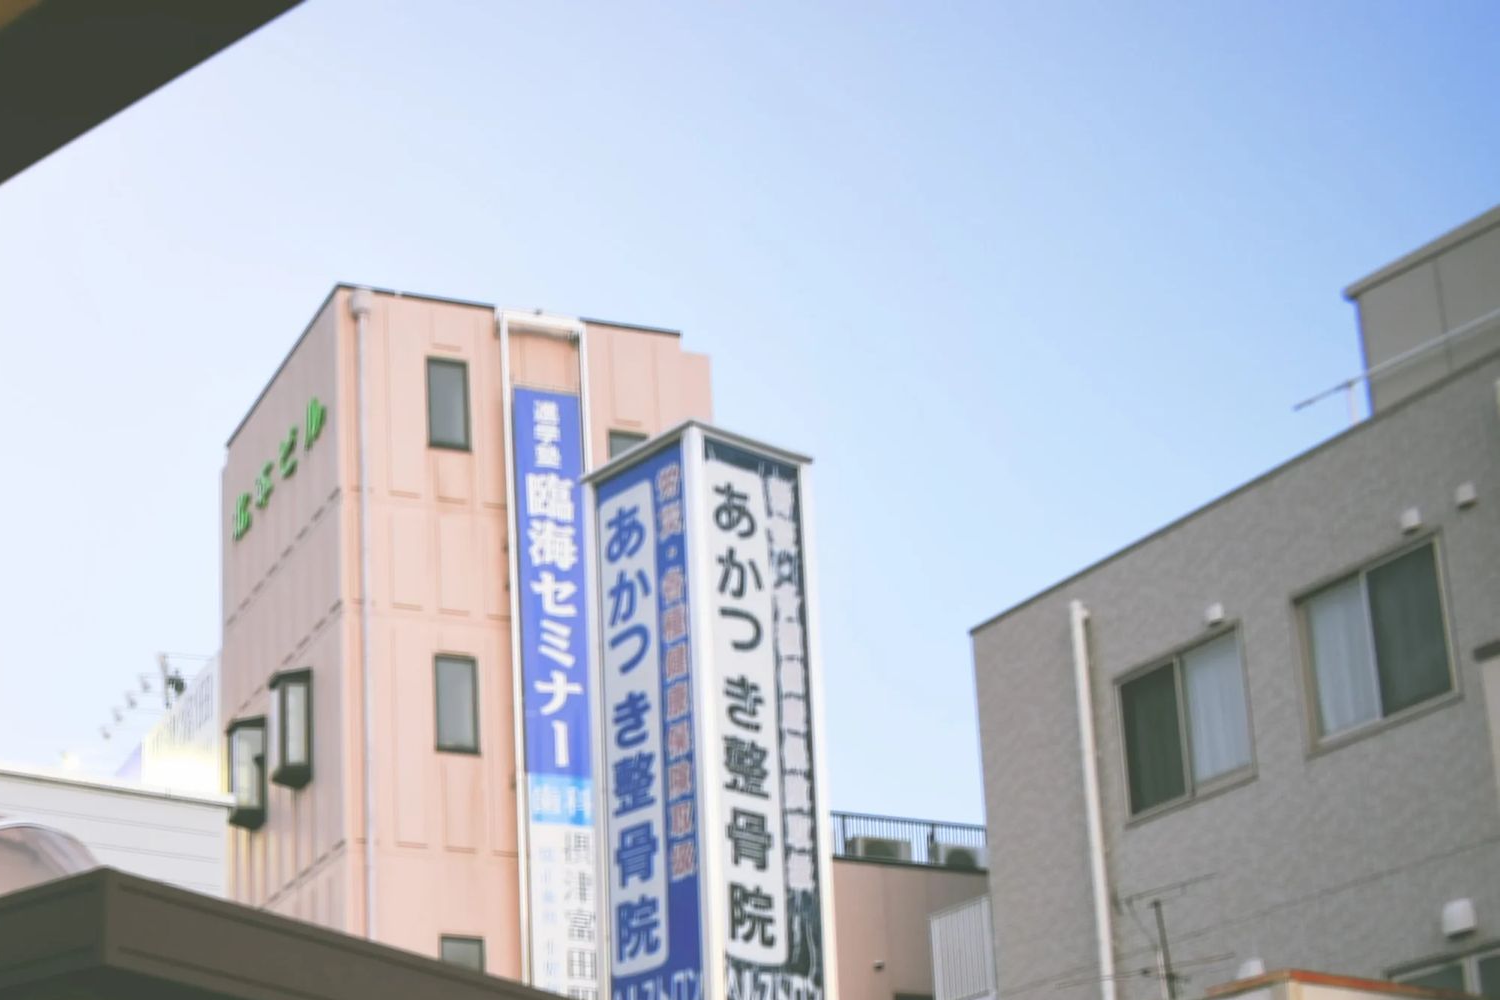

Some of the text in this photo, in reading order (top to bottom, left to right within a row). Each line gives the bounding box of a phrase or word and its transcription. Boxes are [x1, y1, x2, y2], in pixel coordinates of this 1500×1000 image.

[525, 472, 584, 768] 臨海セミナー
[604, 503, 662, 964] あかつき整骨院
[712, 481, 777, 948] あかつき整骨院
